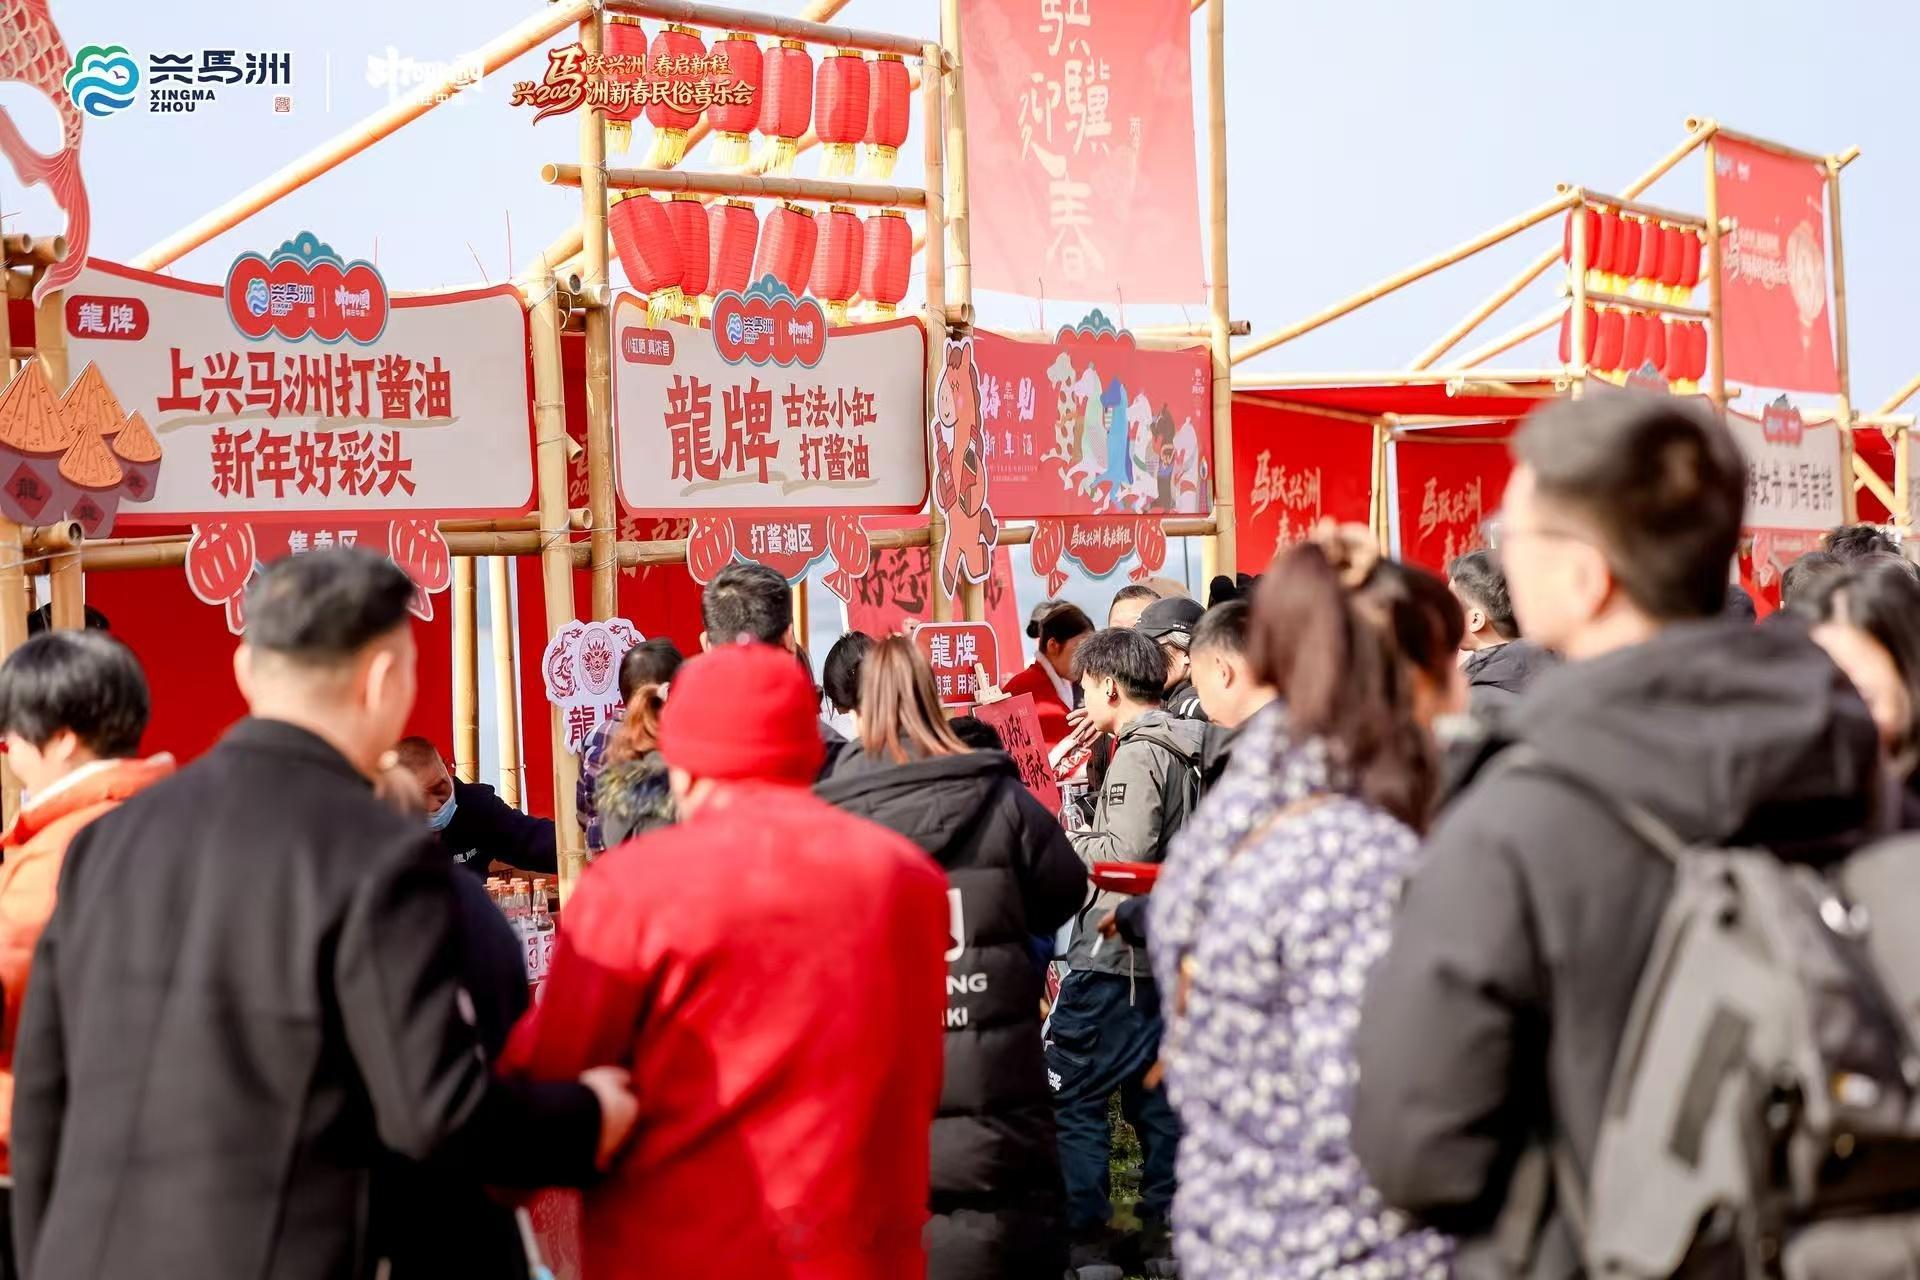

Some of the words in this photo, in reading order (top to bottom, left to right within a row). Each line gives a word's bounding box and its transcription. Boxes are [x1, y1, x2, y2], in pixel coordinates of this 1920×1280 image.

[78, 302, 137, 334] 龍牌
[647, 339, 670, 356] 真浓香
[156, 347, 451, 419] 上兴马洲打酱油
[663, 374, 780, 484] 龍牌
[781, 382, 878, 429] 古法小缸
[211, 426, 417, 498] 新年好彩头
[799, 433, 870, 481] 打酱油
[750, 523, 814, 554] 打酱油区
[929, 632, 979, 669] 龍牌
[942, 1006, 968, 1027] KI
